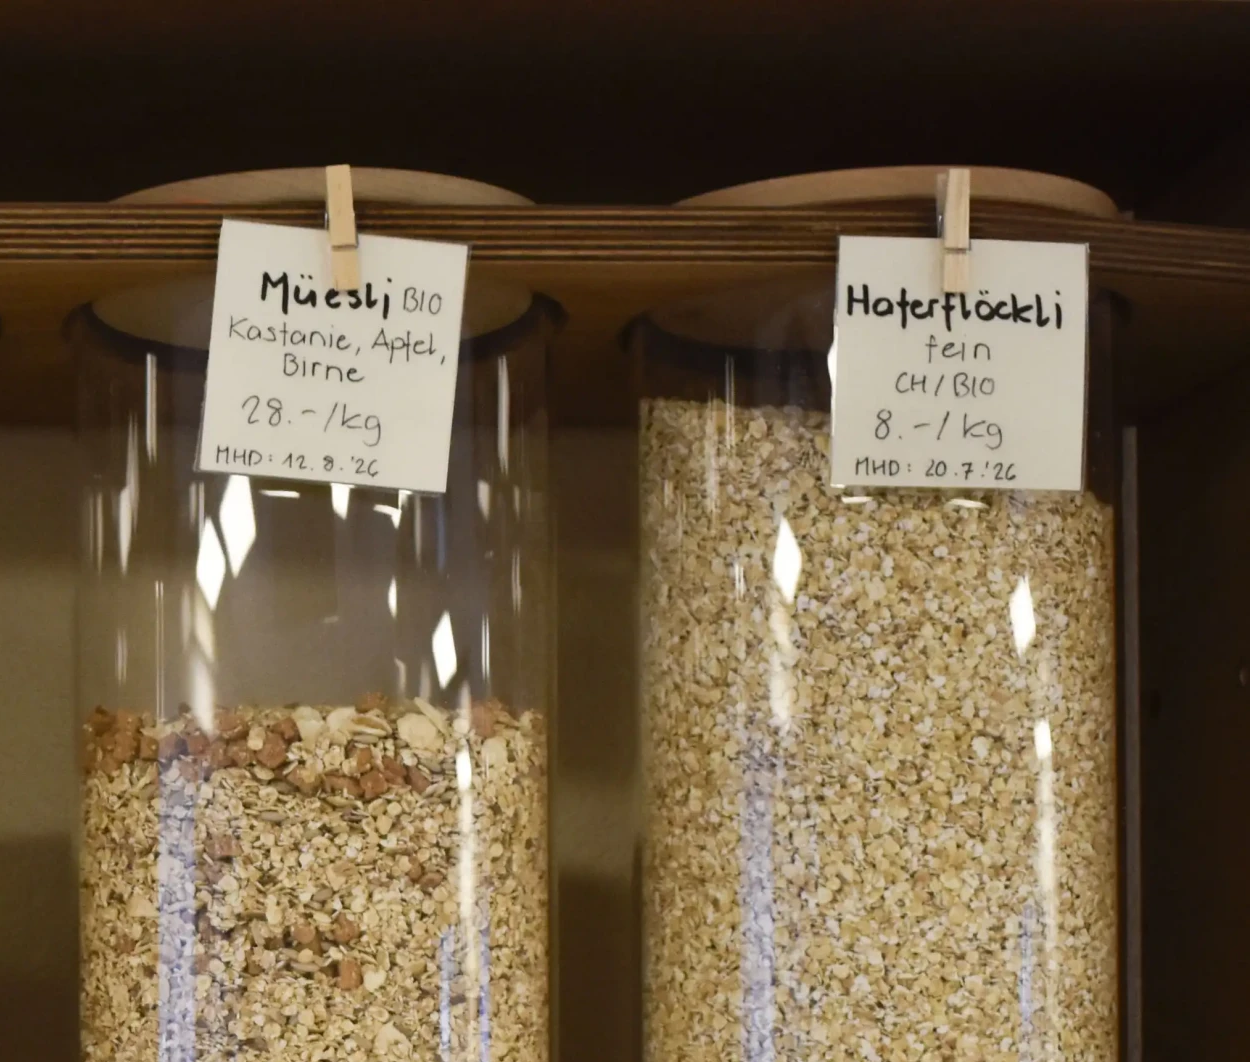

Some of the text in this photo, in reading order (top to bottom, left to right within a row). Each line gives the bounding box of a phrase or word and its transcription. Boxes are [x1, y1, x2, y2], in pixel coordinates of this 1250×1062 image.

[403, 287, 442, 315] BIO
[228, 316, 361, 356] Kastanie,
[925, 334, 991, 363] fein
[283, 352, 366, 383] Birne
